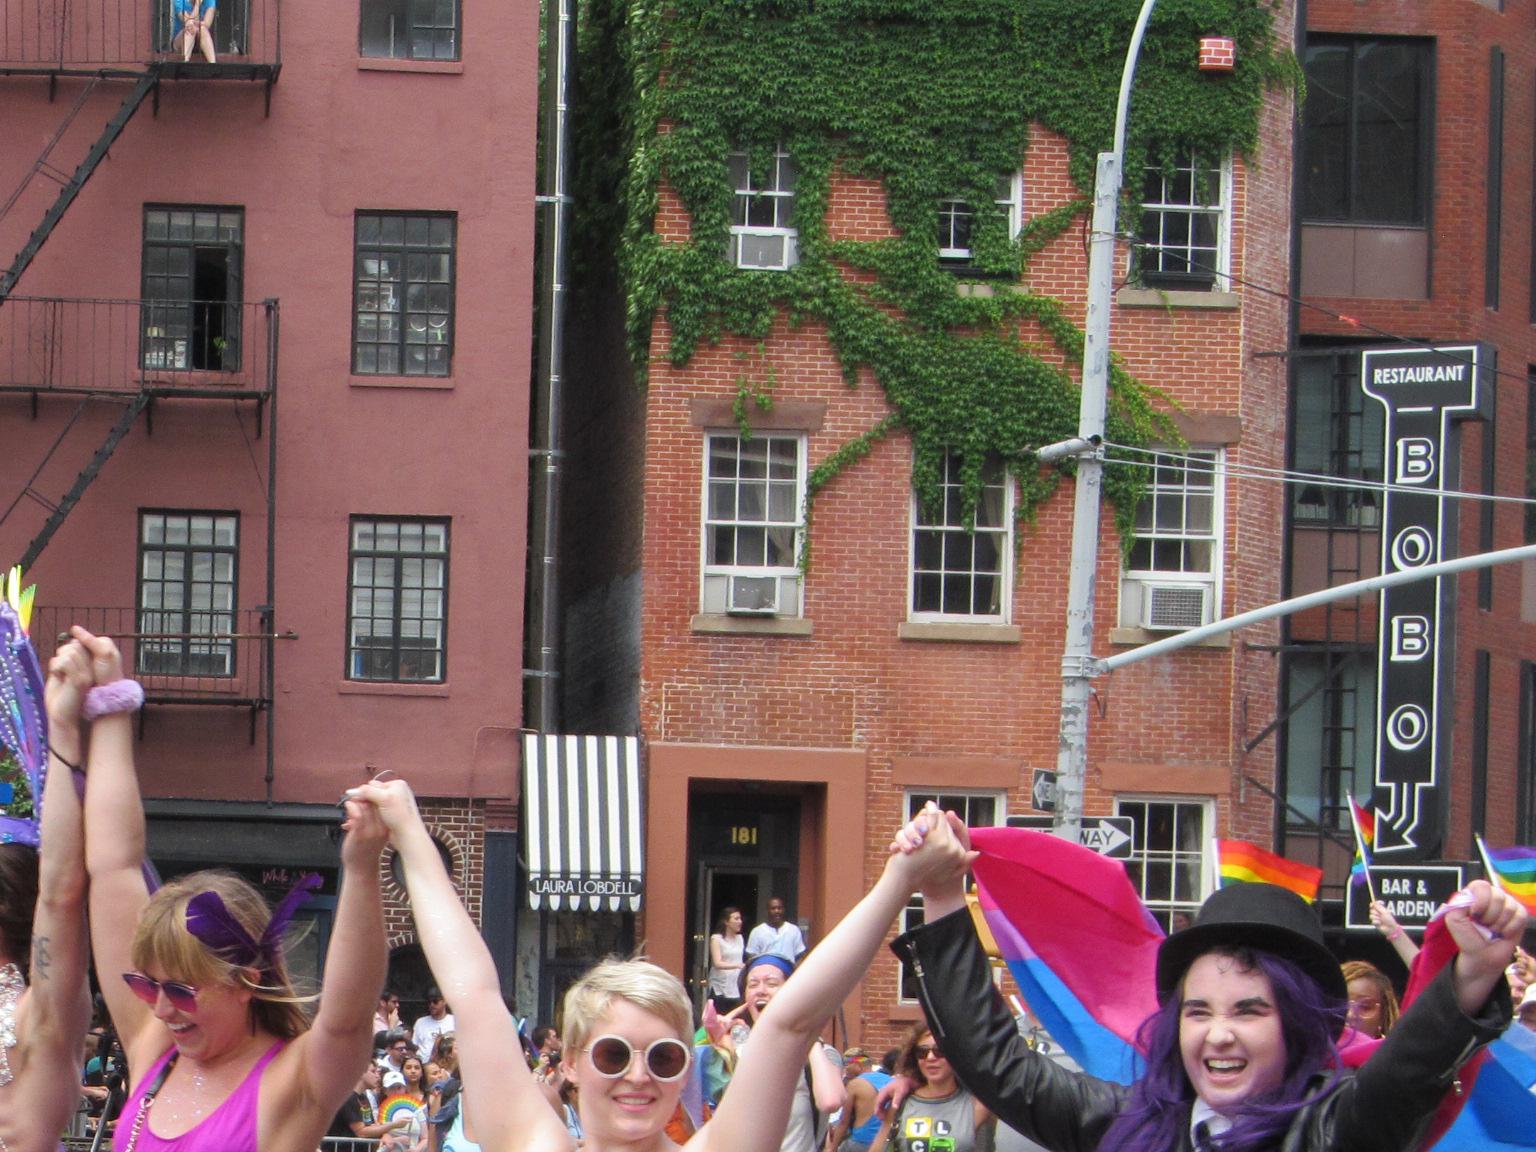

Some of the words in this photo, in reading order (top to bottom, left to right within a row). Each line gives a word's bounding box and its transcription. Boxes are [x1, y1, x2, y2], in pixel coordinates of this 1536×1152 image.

[1373, 364, 1465, 385] RESTAURANT
[1386, 437, 1434, 751] BOBO
[731, 826, 758, 845] 181
[535, 879, 575, 894] LAURA
[578, 880, 635, 896] LOBDELL
[1381, 878, 1410, 895] BAR
[1416, 879, 1427, 895] &
[1378, 900, 1435, 917] ARDEN
